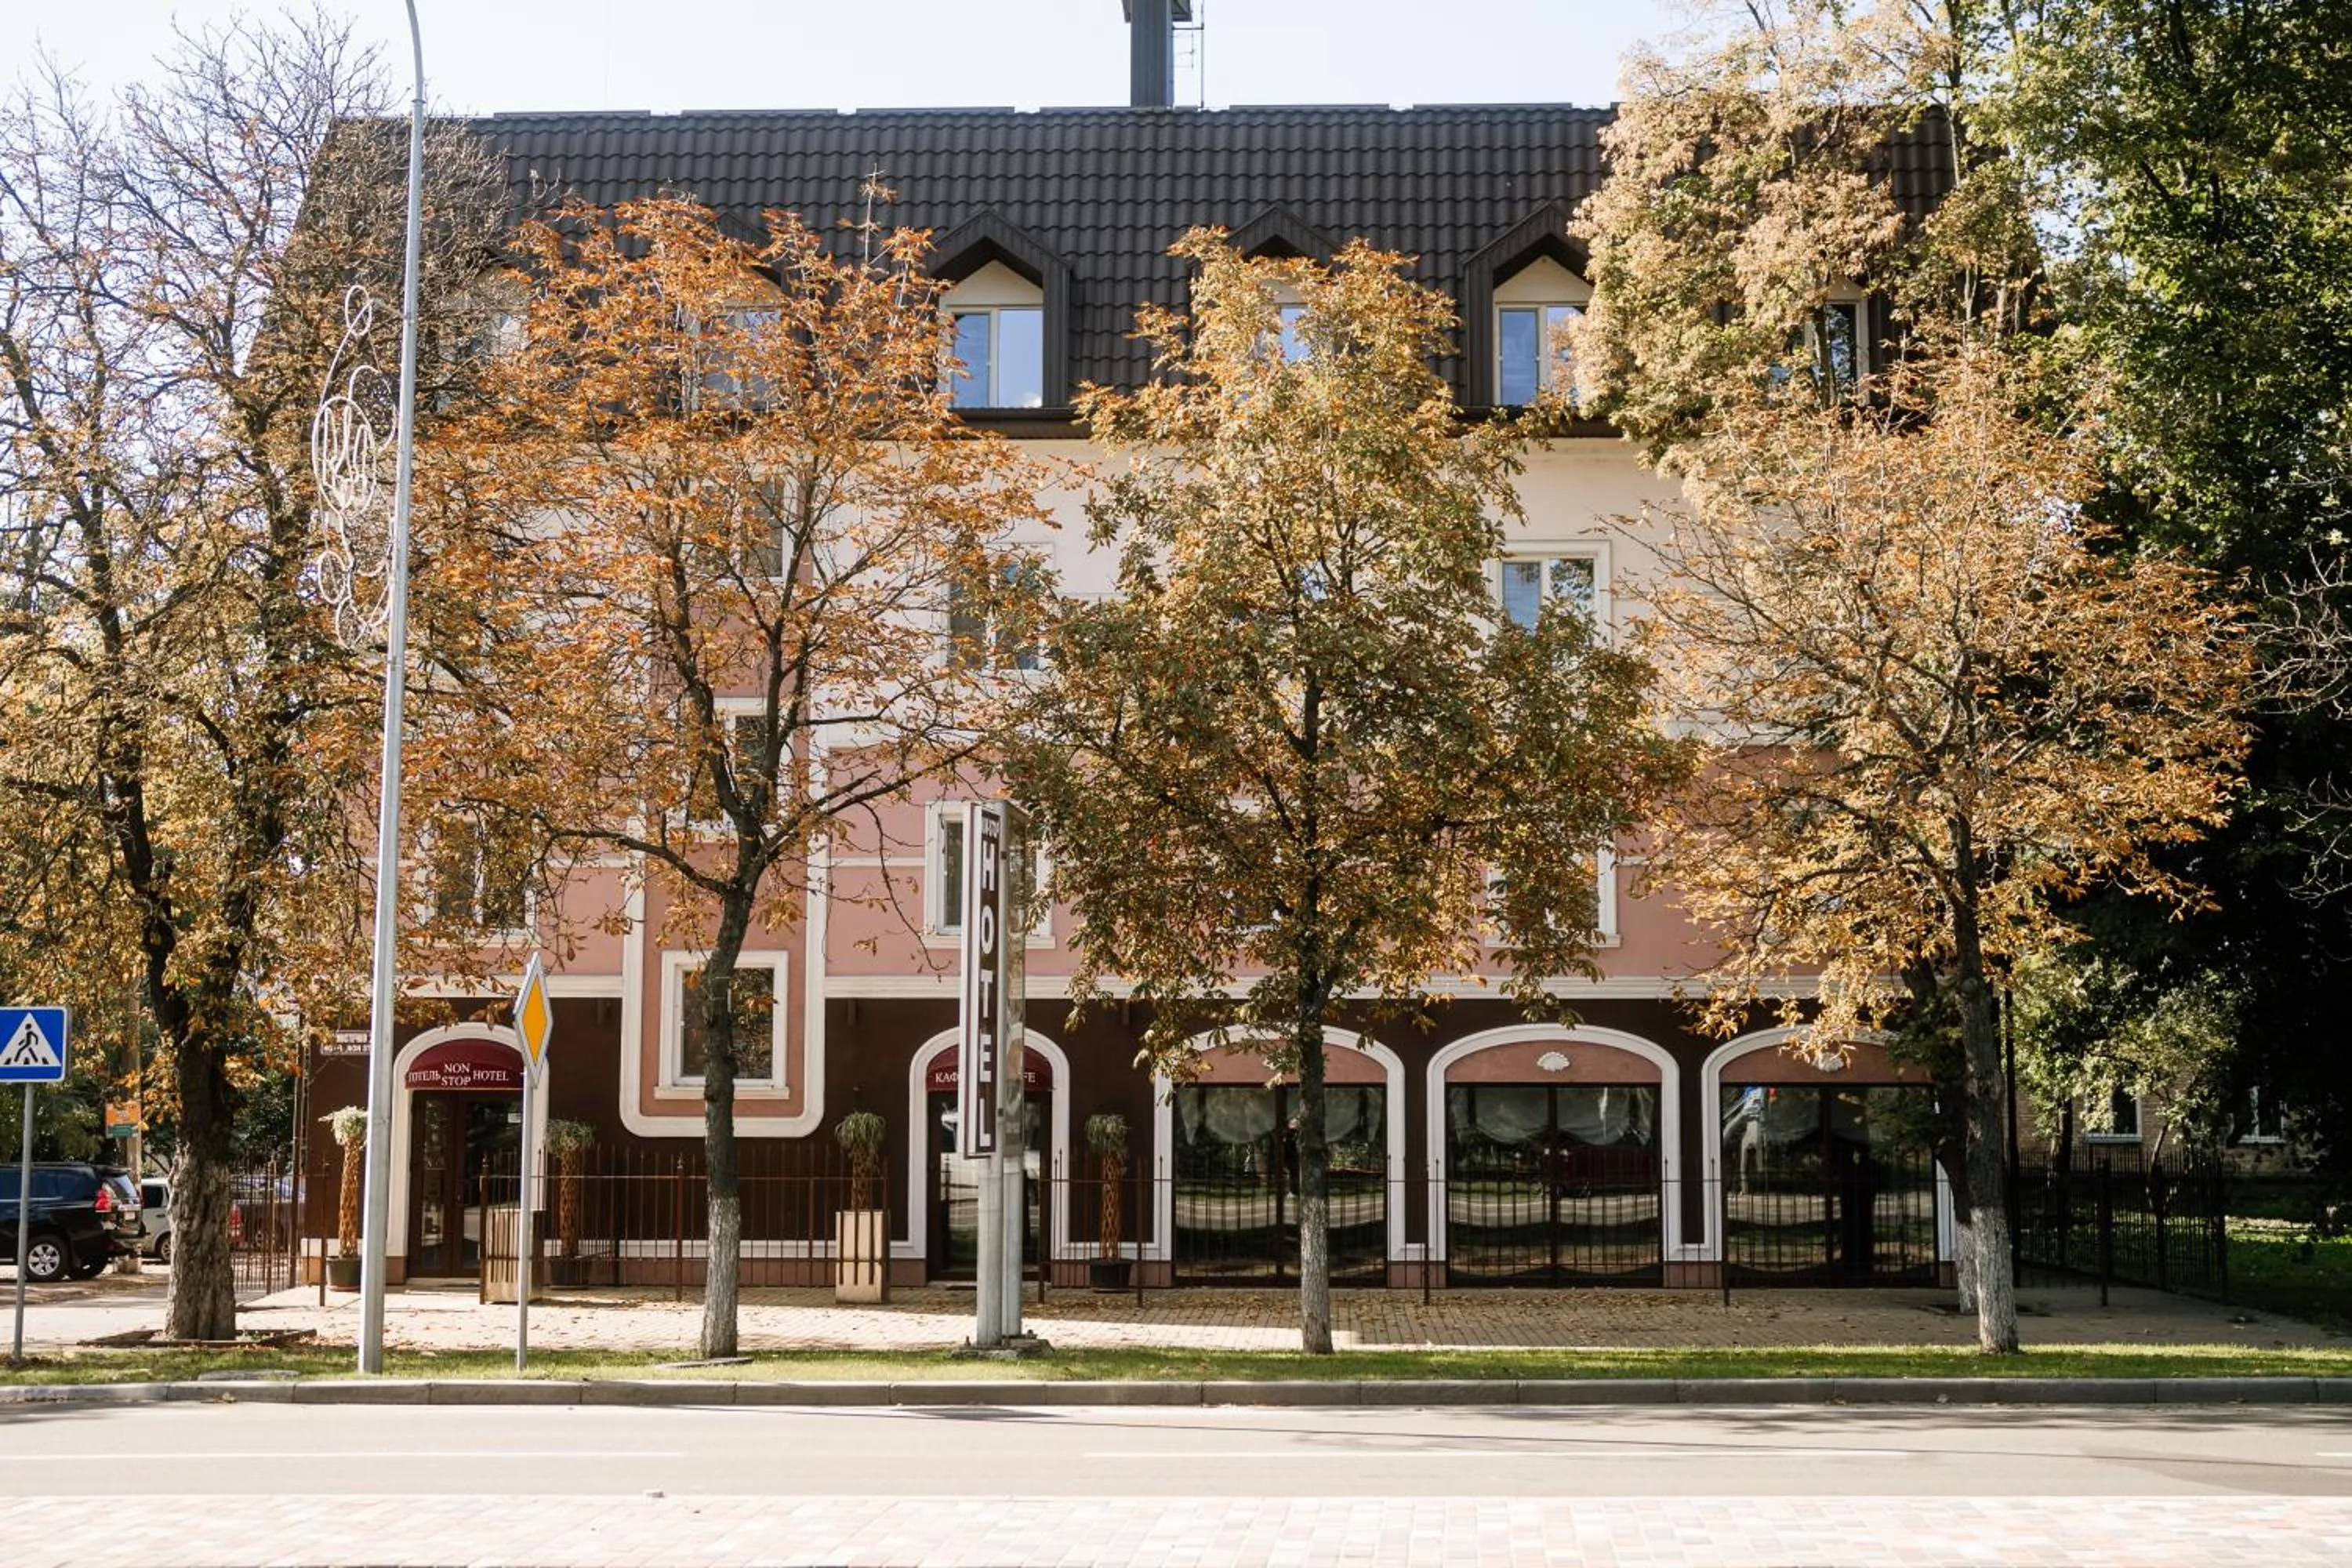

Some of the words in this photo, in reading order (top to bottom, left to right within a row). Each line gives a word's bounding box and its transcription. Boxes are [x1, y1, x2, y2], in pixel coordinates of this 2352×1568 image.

[979, 840, 995, 1147] HOTEL
[444, 1062, 470, 1073] NON
[441, 1075, 471, 1087] STOP
[472, 1070, 509, 1082] HOTEL
